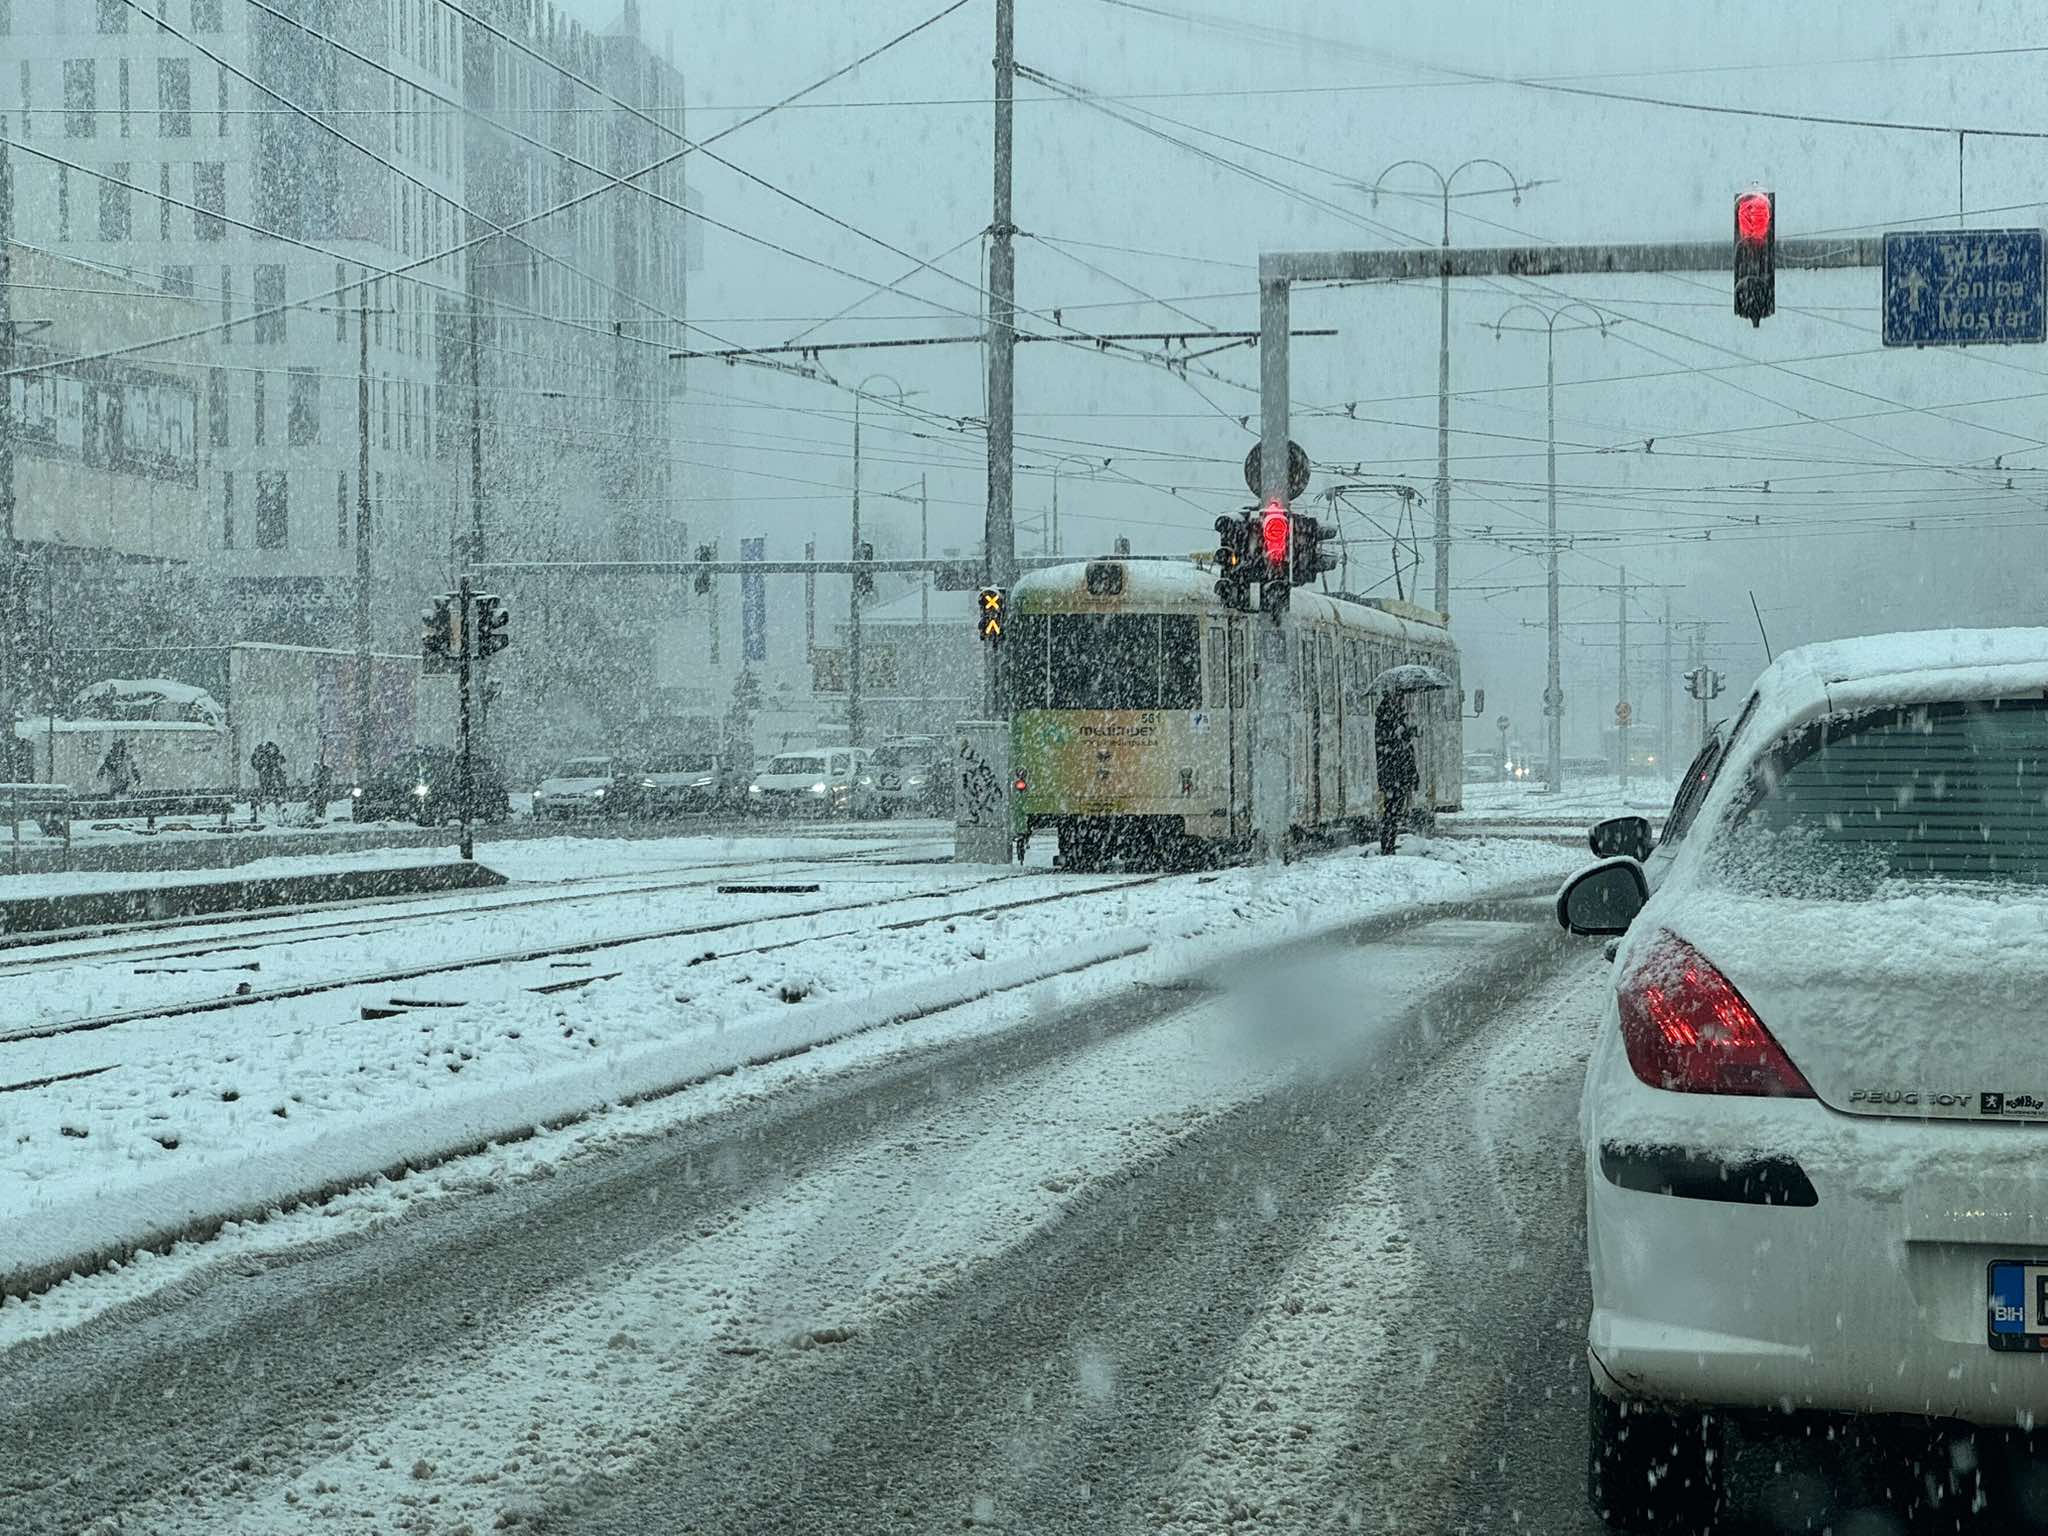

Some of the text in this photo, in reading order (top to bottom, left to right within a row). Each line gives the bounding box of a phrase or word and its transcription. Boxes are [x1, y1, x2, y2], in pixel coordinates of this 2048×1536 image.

[1939, 244, 2009, 266] Tuzla
[1939, 276, 2025, 298] Zenica
[1939, 300, 2031, 329] Mostar
[1995, 1306, 2024, 1322] BIH
